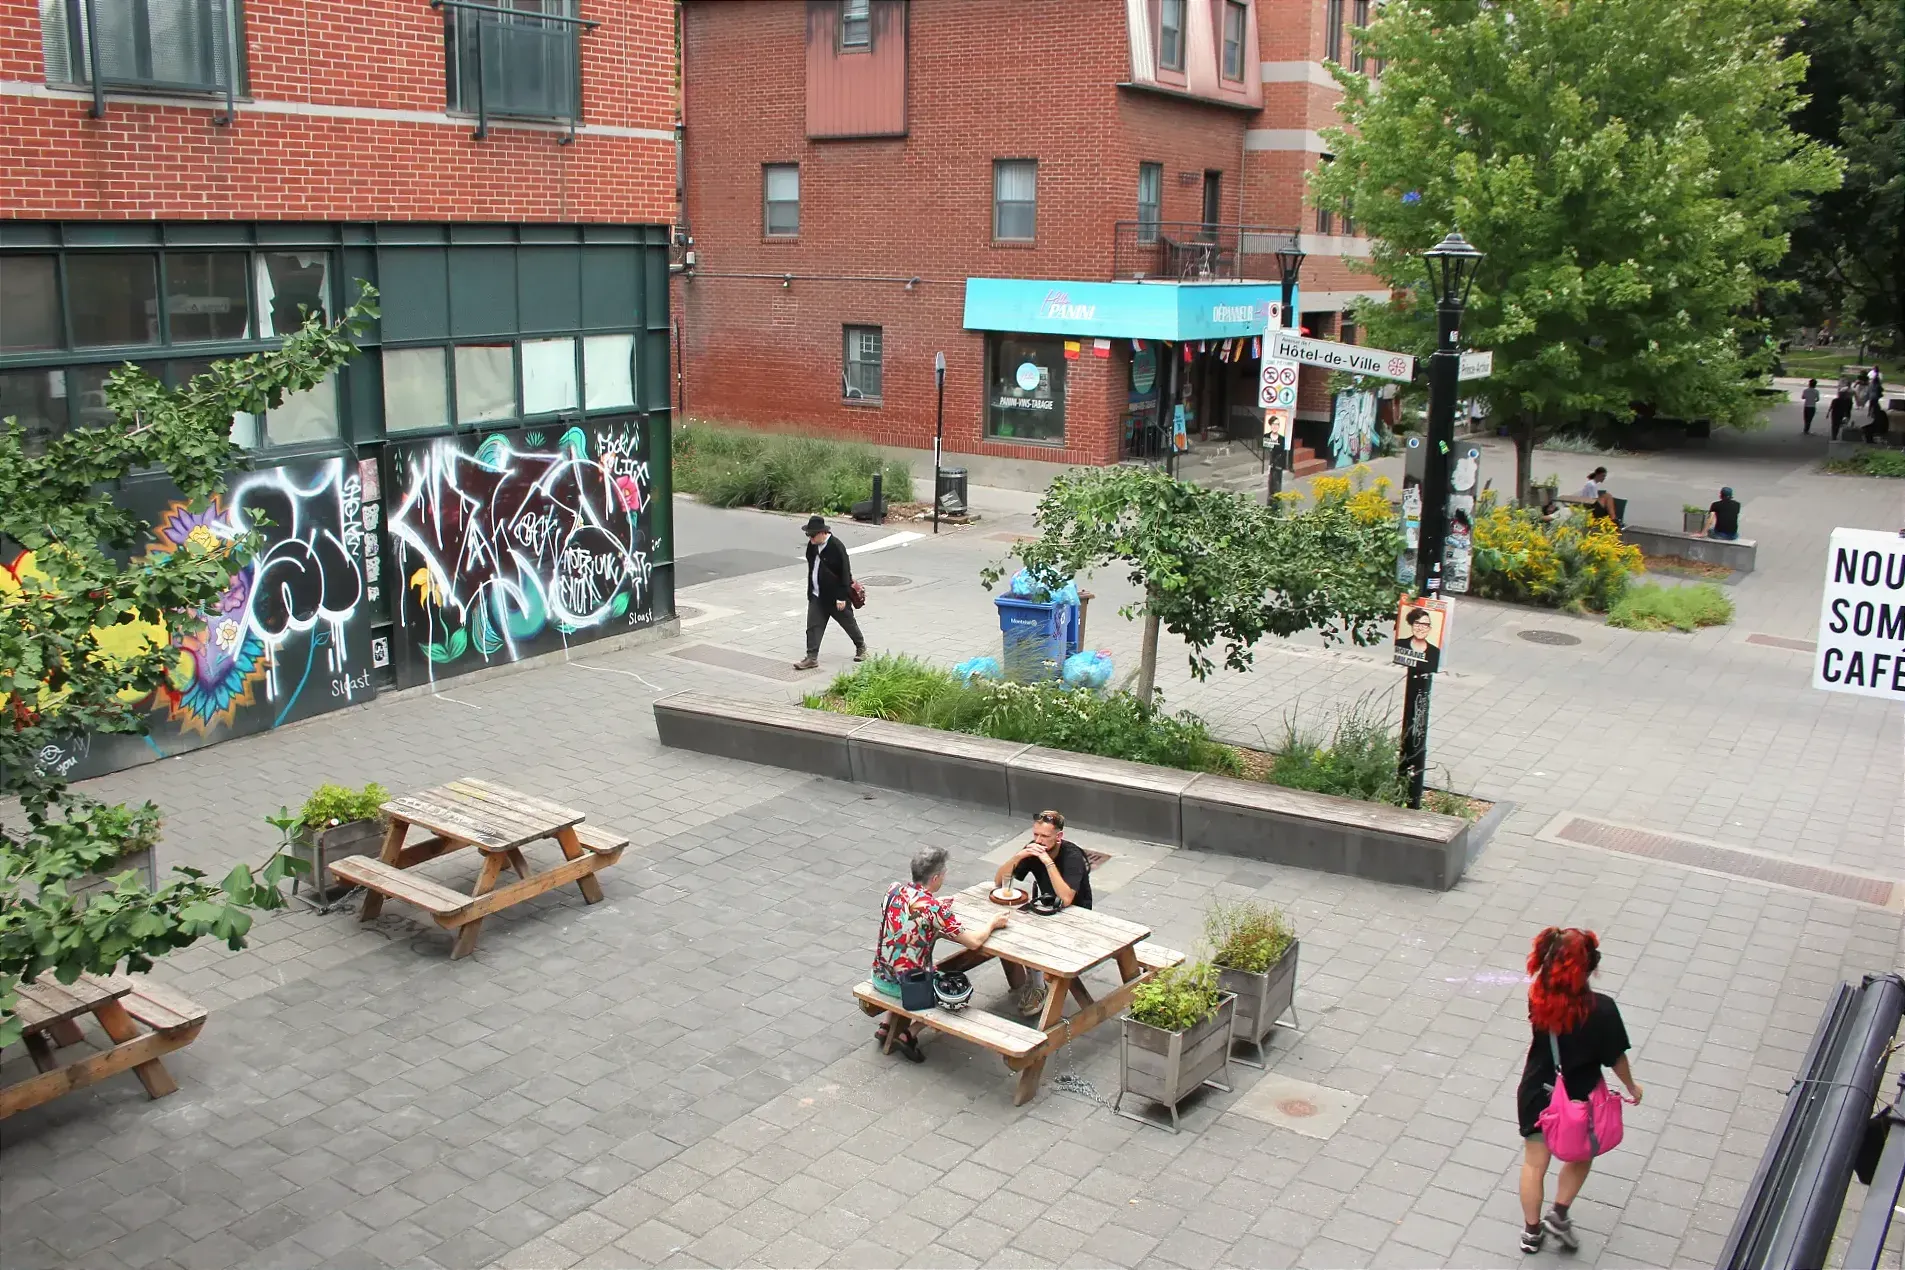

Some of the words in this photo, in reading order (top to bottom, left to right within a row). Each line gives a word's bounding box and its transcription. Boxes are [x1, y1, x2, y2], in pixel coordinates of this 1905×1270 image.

[1048, 304, 1096, 320] PANINI
[1280, 343, 1381, 372] Hôtel-de-Ville
[1834, 548, 1905, 590] NOU
[1829, 598, 1905, 641] SOM
[56, 756, 79, 776] you
